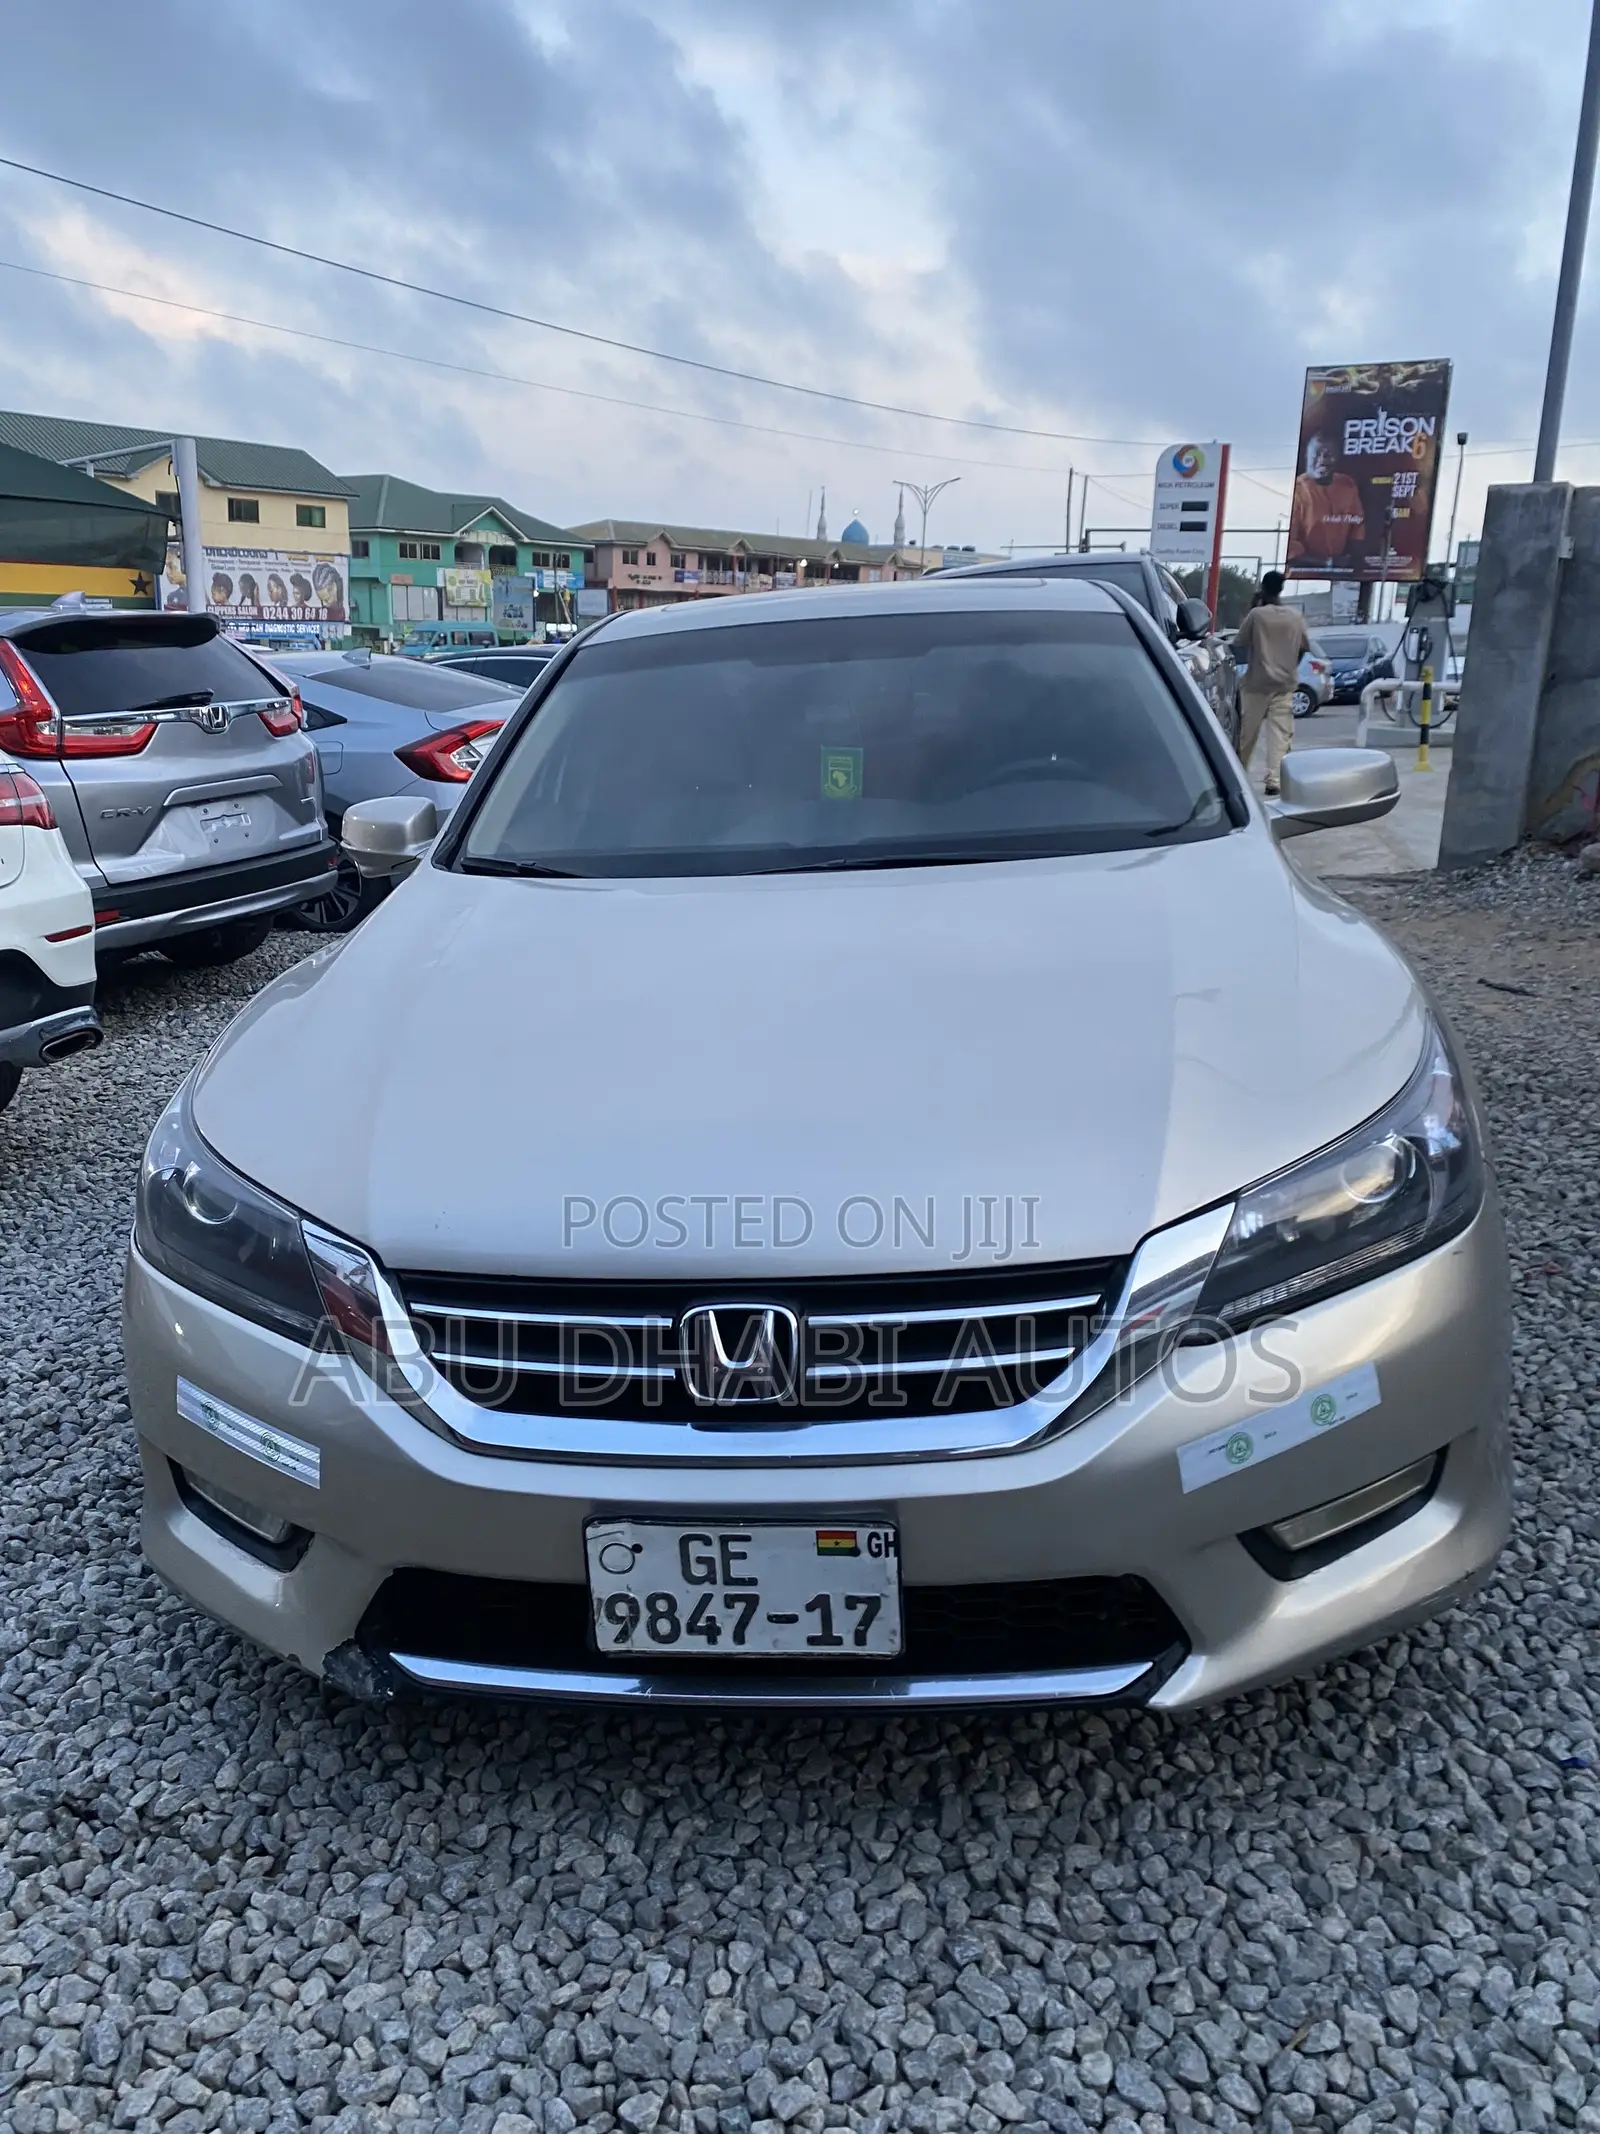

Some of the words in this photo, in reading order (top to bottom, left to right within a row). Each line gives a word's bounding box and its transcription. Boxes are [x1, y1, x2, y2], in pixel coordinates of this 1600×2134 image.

[1344, 410, 1436, 438] PRISON
[1344, 437, 1413, 455] BREAK
[1393, 472, 1419, 485] 21ST
[1391, 484, 1417, 498] SEPT
[238, 606, 258, 616] SALON
[262, 606, 289, 620] 0244
[291, 607, 303, 620] 30
[304, 607, 316, 620] 64
[264, 623, 296, 634] DIAGNOSTIC
[296, 624, 320, 634] SERVICES
[100, 805, 152, 819] CR-V
[867, 1531, 898, 1558] GH
[678, 1532, 759, 1587] GE
[604, 1591, 882, 1647] 9847-17
